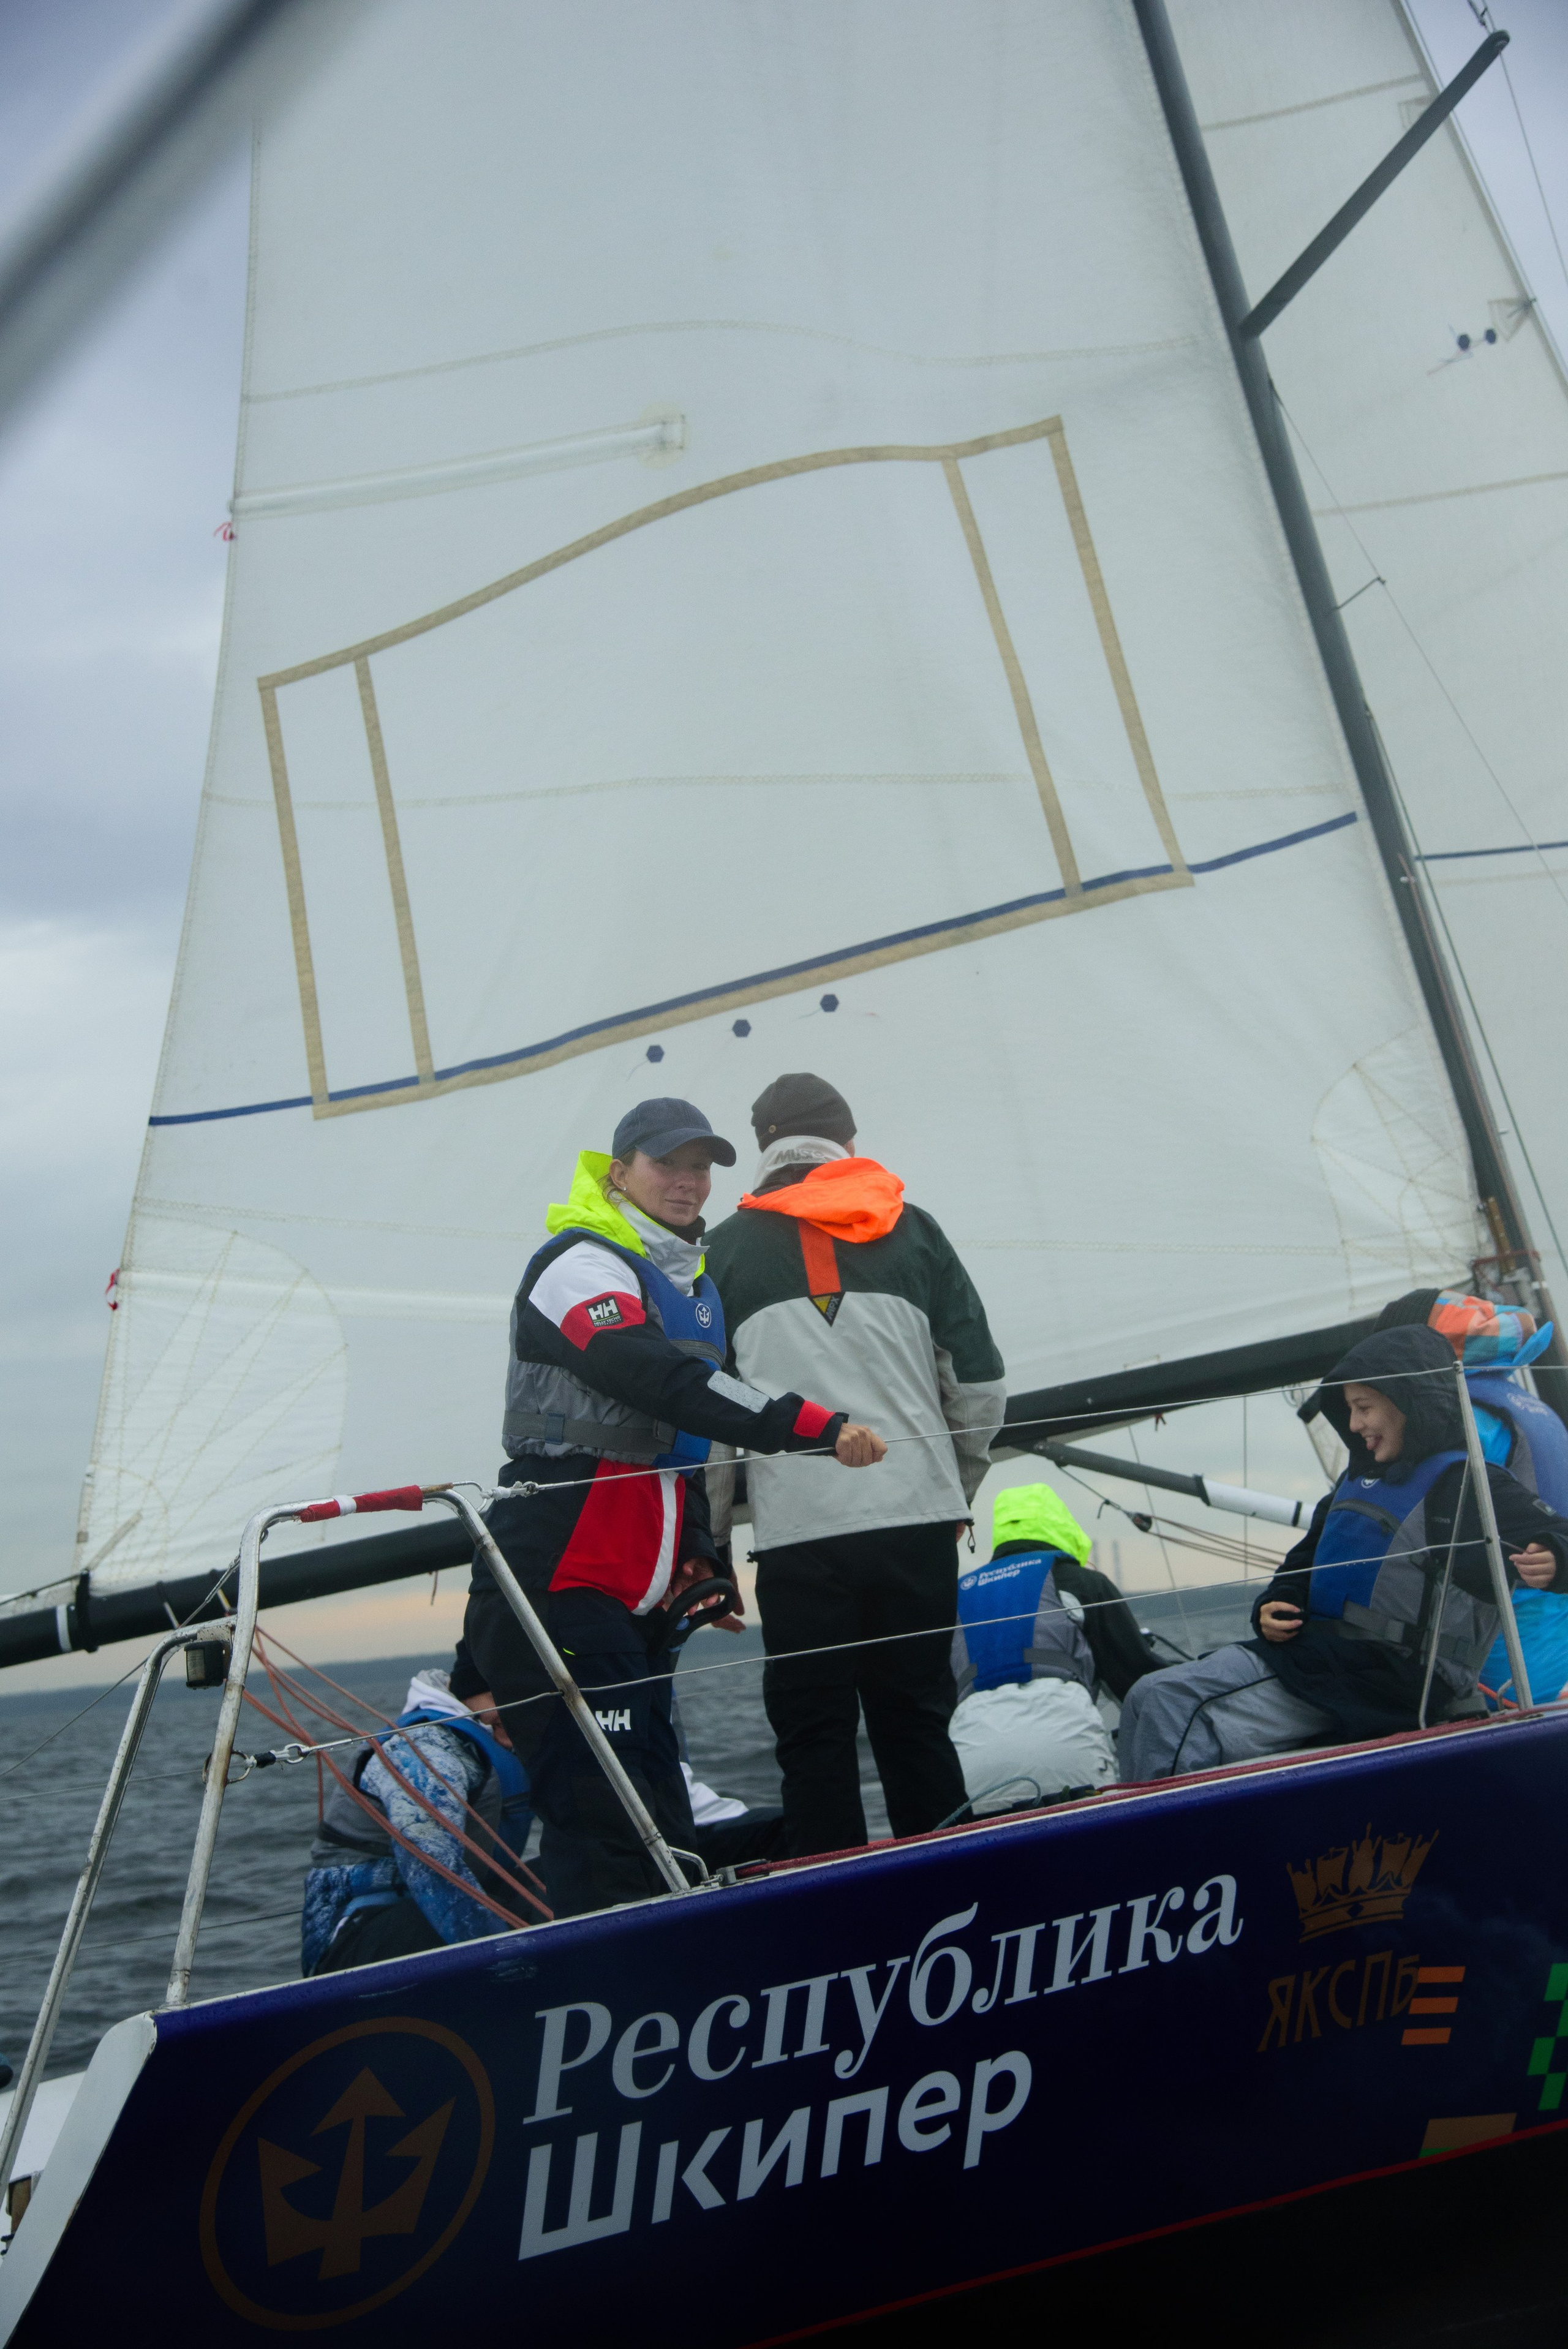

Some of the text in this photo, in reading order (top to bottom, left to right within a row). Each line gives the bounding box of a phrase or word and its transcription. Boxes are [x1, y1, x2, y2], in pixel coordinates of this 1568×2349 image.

[588, 1299, 619, 1321] HH
[595, 1708, 631, 1732] HH
[522, 1874, 1244, 2125] Республика
[1257, 1951, 1420, 2052] ЯКСПБ
[518, 2050, 1033, 2261] Шкипер
